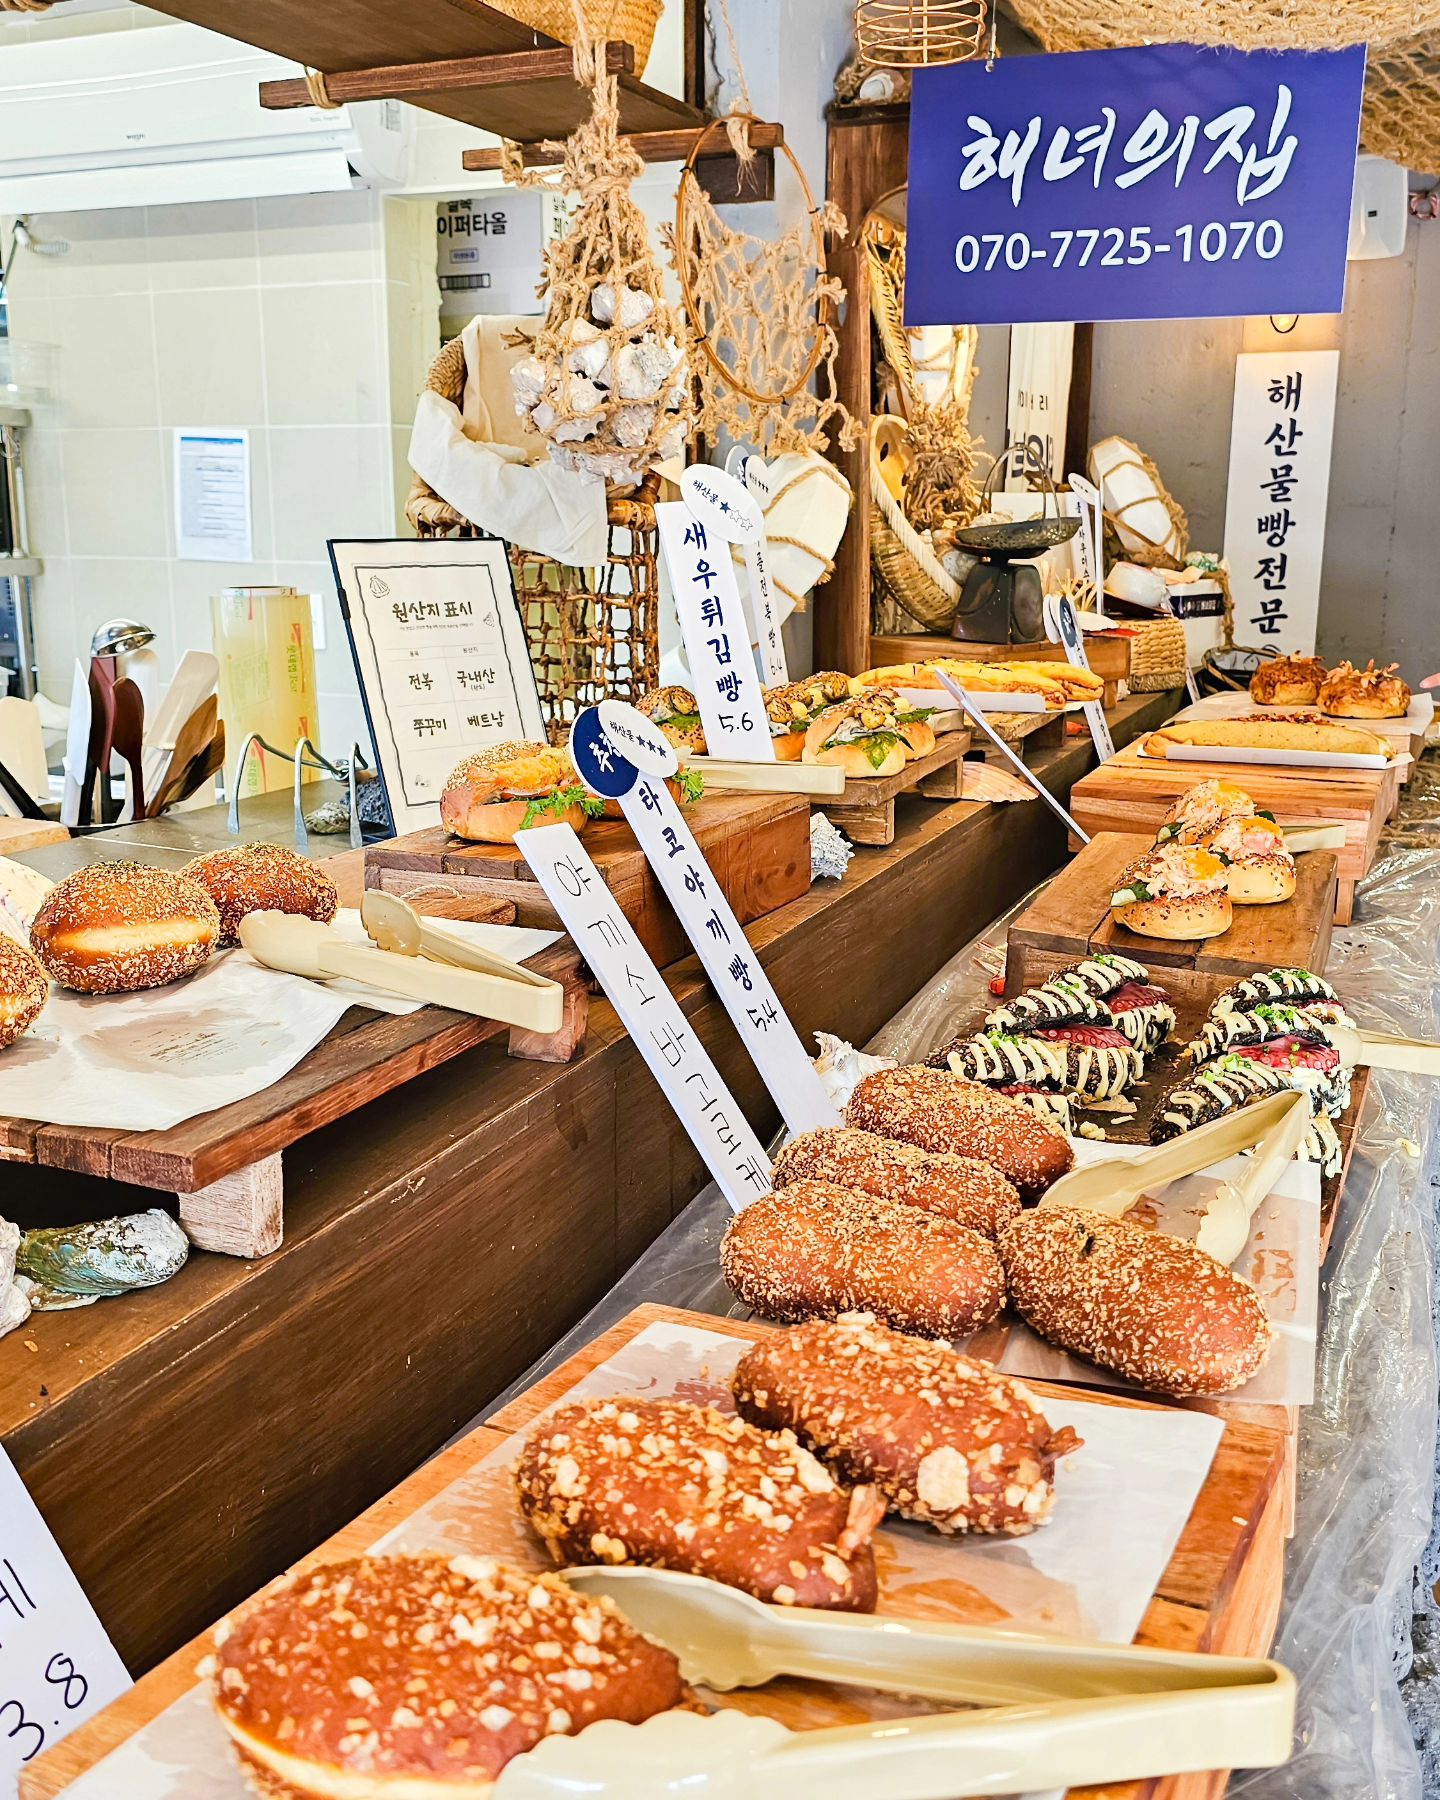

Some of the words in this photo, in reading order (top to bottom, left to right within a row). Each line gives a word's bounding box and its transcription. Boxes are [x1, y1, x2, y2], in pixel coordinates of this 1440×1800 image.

[958, 83, 1299, 208] 해녀의집
[954, 218, 1285, 273] 070-7725-1070
[392, 600, 440, 623] 원산지
[443, 601, 474, 618] 표시
[683, 519, 743, 702] 새우튀김빵
[408, 673, 434, 691] 전복
[456, 667, 495, 689] 국내산
[466, 711, 505, 728] 베트남
[718, 712, 754, 733] 5.6
[638, 780, 753, 992] 타코야끼빵
[553, 854, 771, 1192] 야끼소바고로케
[745, 998, 779, 1032] 5.4
[0, 1653, 88, 1761] 3.8
